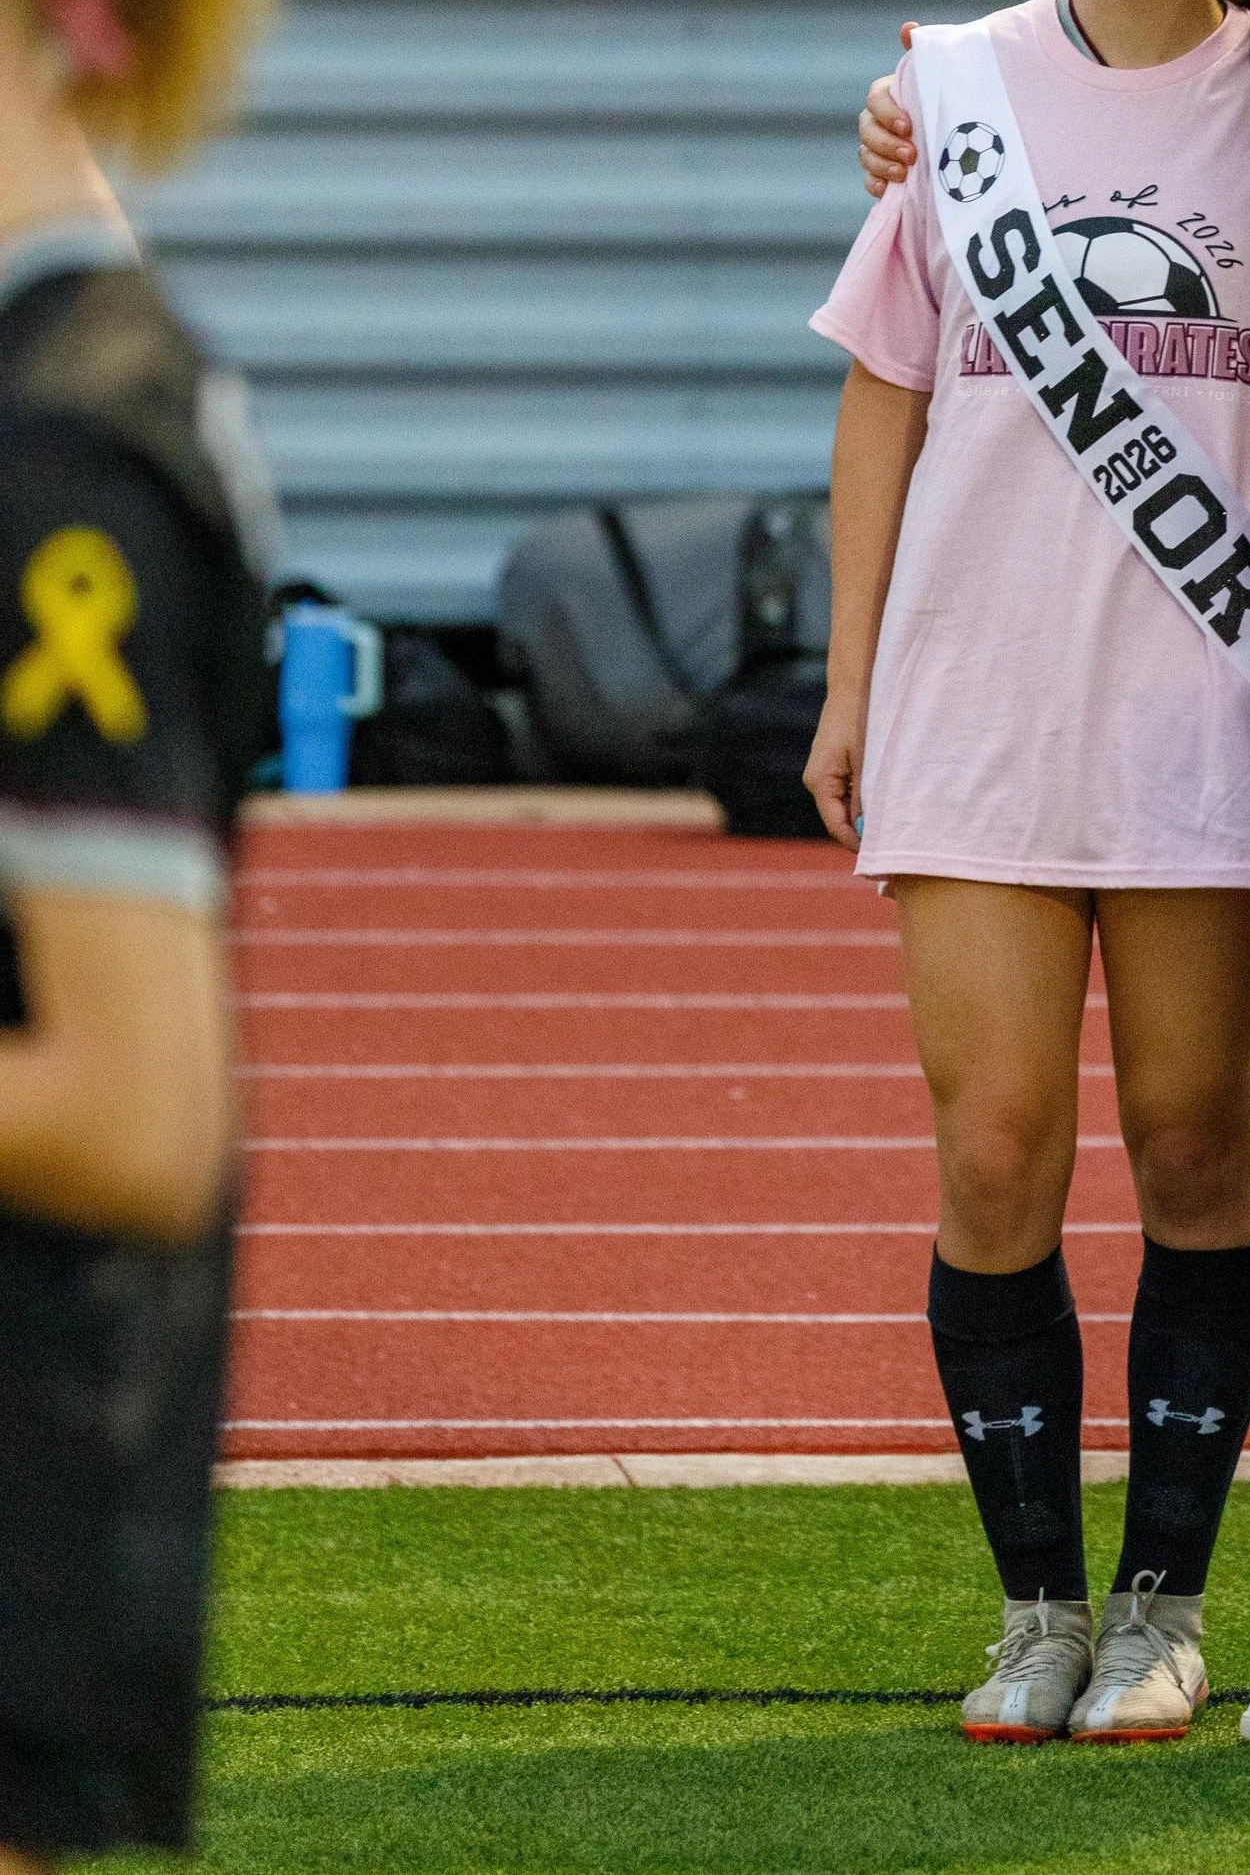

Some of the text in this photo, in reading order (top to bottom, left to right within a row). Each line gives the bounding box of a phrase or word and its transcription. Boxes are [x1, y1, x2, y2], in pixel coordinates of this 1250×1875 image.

[1109, 184, 1158, 208] of
[1176, 212, 1245, 269] 2026
[1092, 423, 1178, 505] 2026
